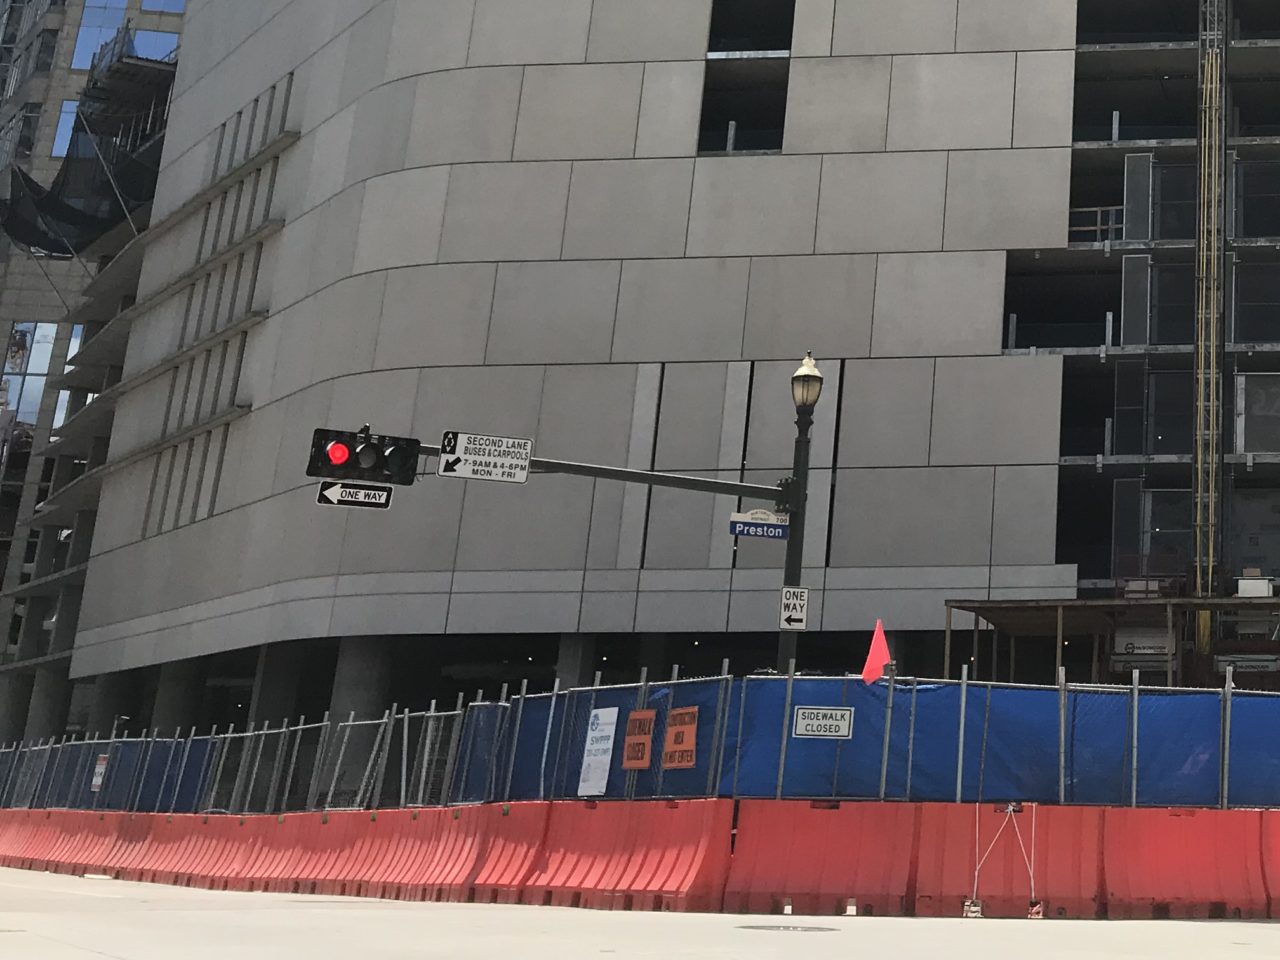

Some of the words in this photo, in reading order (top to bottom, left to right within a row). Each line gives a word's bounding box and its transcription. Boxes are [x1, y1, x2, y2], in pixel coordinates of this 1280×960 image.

[467, 436, 503, 448] SECOND
[506, 440, 529, 451] LANE
[463, 446, 486, 457] BUSES
[487, 448, 492, 457] &
[492, 448, 529, 461] CARPOOLS
[463, 458, 491, 468] 7-9AM
[499, 462, 527, 472] 4-6PM
[471, 468, 493, 477] MON
[501, 471, 516, 479] FRI
[340, 489, 361, 500] ONE
[363, 491, 385, 501] WAY
[735, 523, 783, 537] Preston
[784, 590, 806, 601] ONE
[783, 602, 806, 613] WAY
[801, 711, 847, 722] SIDEWALK
[805, 723, 841, 733] CLOSED
